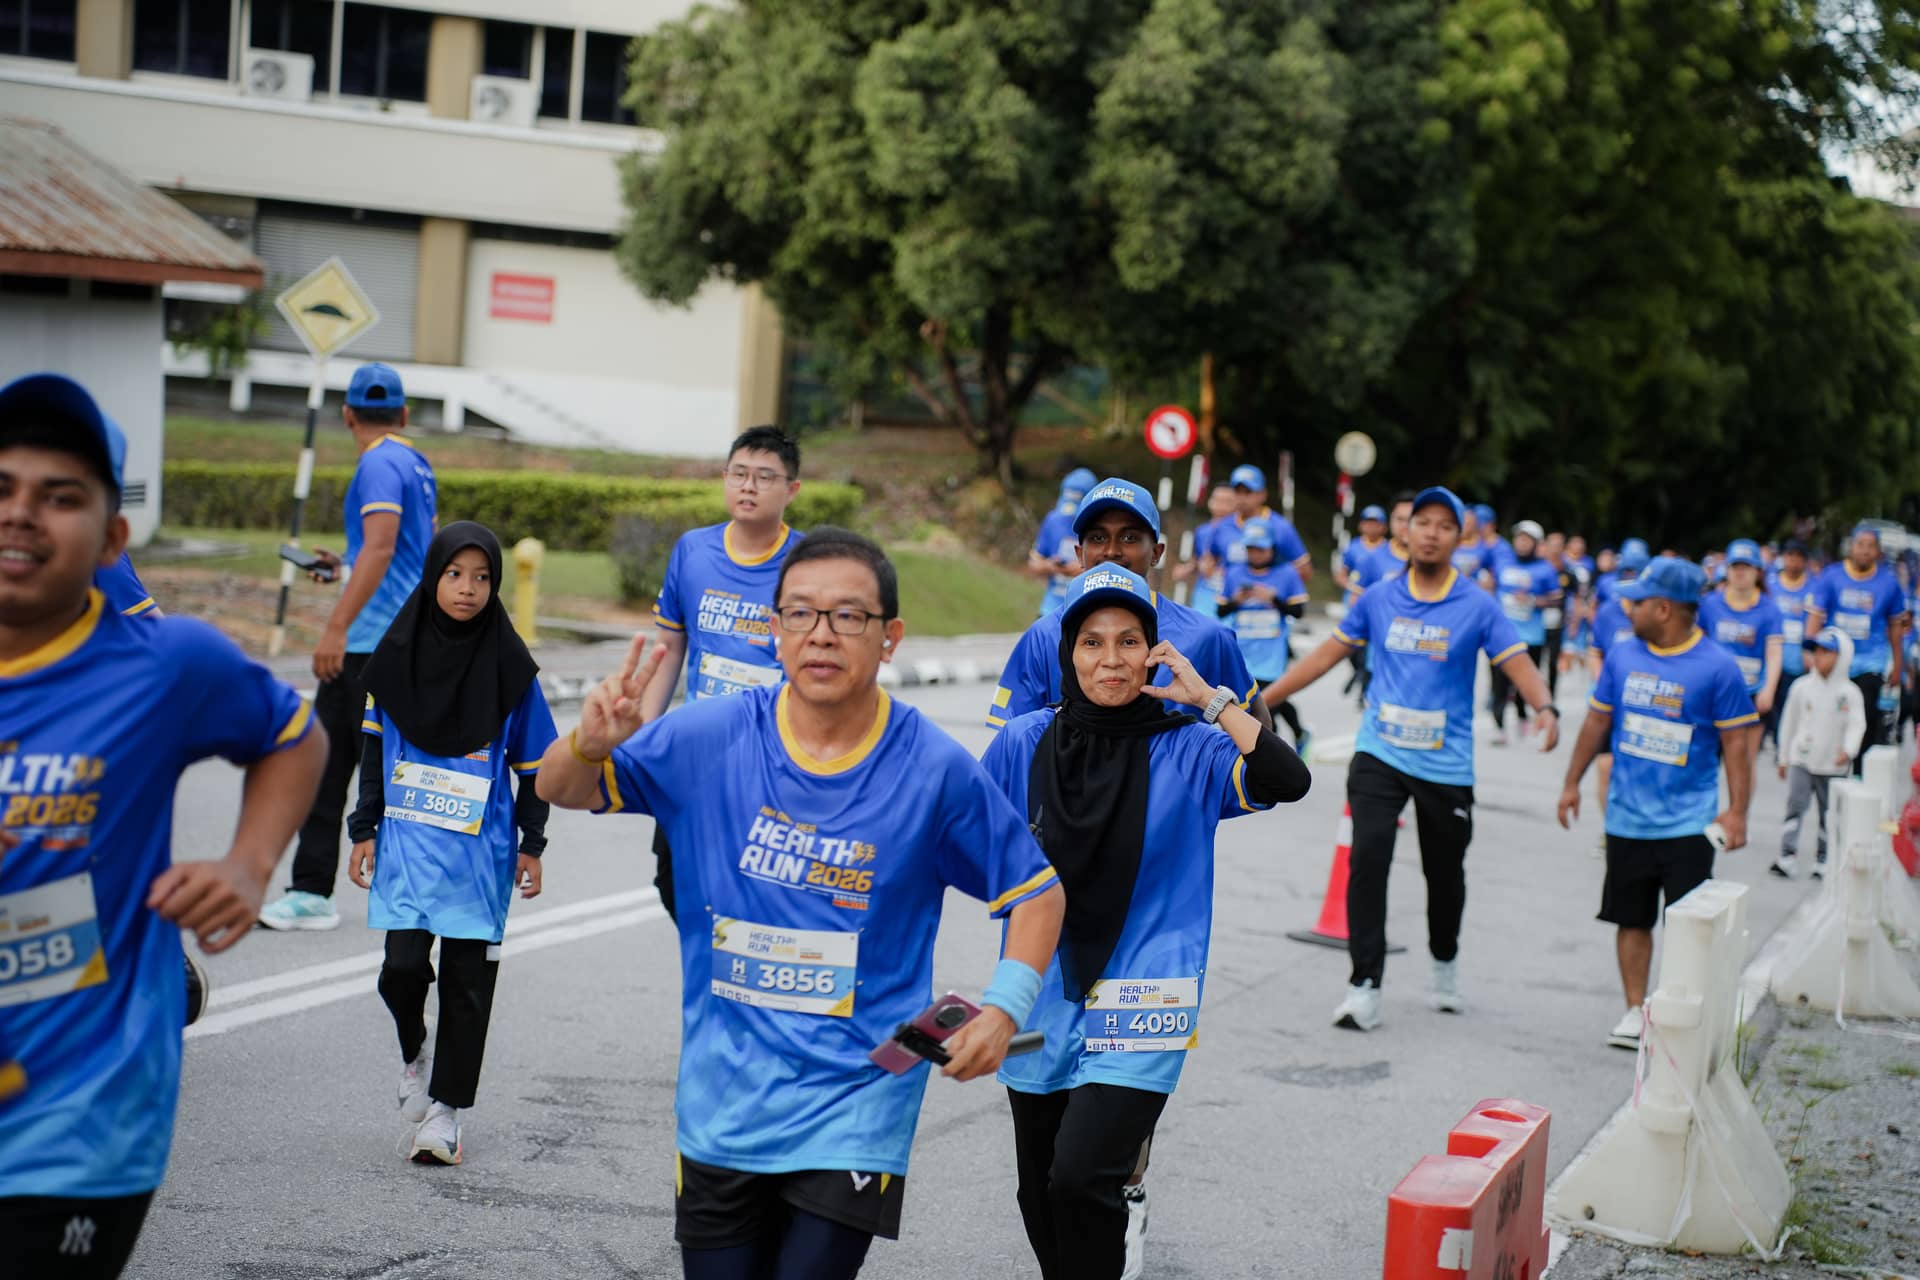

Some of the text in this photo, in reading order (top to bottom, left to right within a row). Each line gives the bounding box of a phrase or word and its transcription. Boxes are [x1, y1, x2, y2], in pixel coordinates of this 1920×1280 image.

[699, 594, 763, 619] HEALTH
[697, 611, 770, 634] RUN 2026
[3, 793, 100, 827] 2026
[405, 789, 472, 819] H 3805
[747, 815, 861, 867] HEALTH
[739, 844, 875, 893] RUN 2026
[748, 942, 771, 953] RUN
[750, 930, 793, 946] HEALTH
[732, 958, 746, 975] H
[757, 963, 836, 995] 3856
[1119, 985, 1154, 995] HEALTH
[1119, 994, 1140, 1004] RUN
[1105, 1011, 1190, 1035] H 4090
